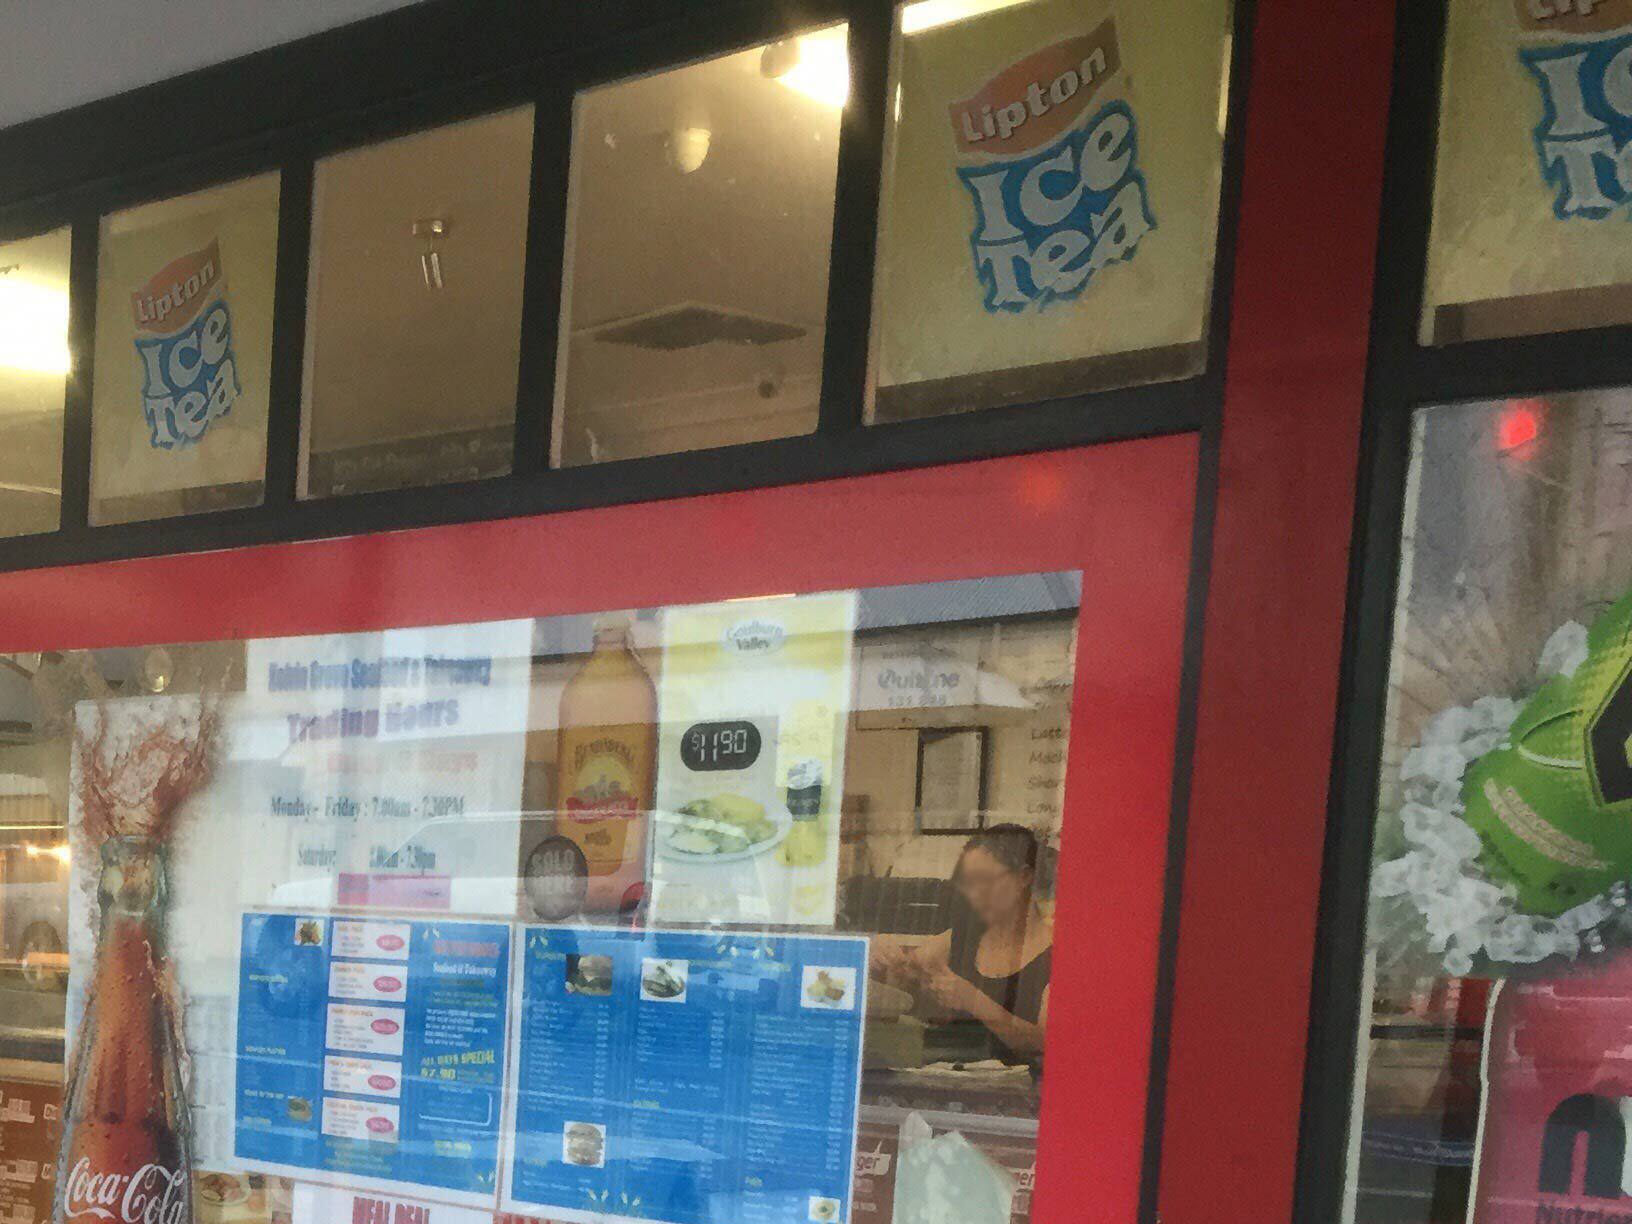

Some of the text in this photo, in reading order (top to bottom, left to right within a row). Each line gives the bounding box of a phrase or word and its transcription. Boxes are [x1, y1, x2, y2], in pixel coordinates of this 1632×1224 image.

[962, 47, 1106, 142] Lipton
[968, 112, 1132, 241] Ice
[976, 181, 1150, 305] Tea
[137, 259, 215, 322] Lipton
[141, 309, 228, 396] Ice
[145, 358, 238, 443] Tea
[736, 636, 771, 651] Valley
[271, 796, 310, 823] Monday
